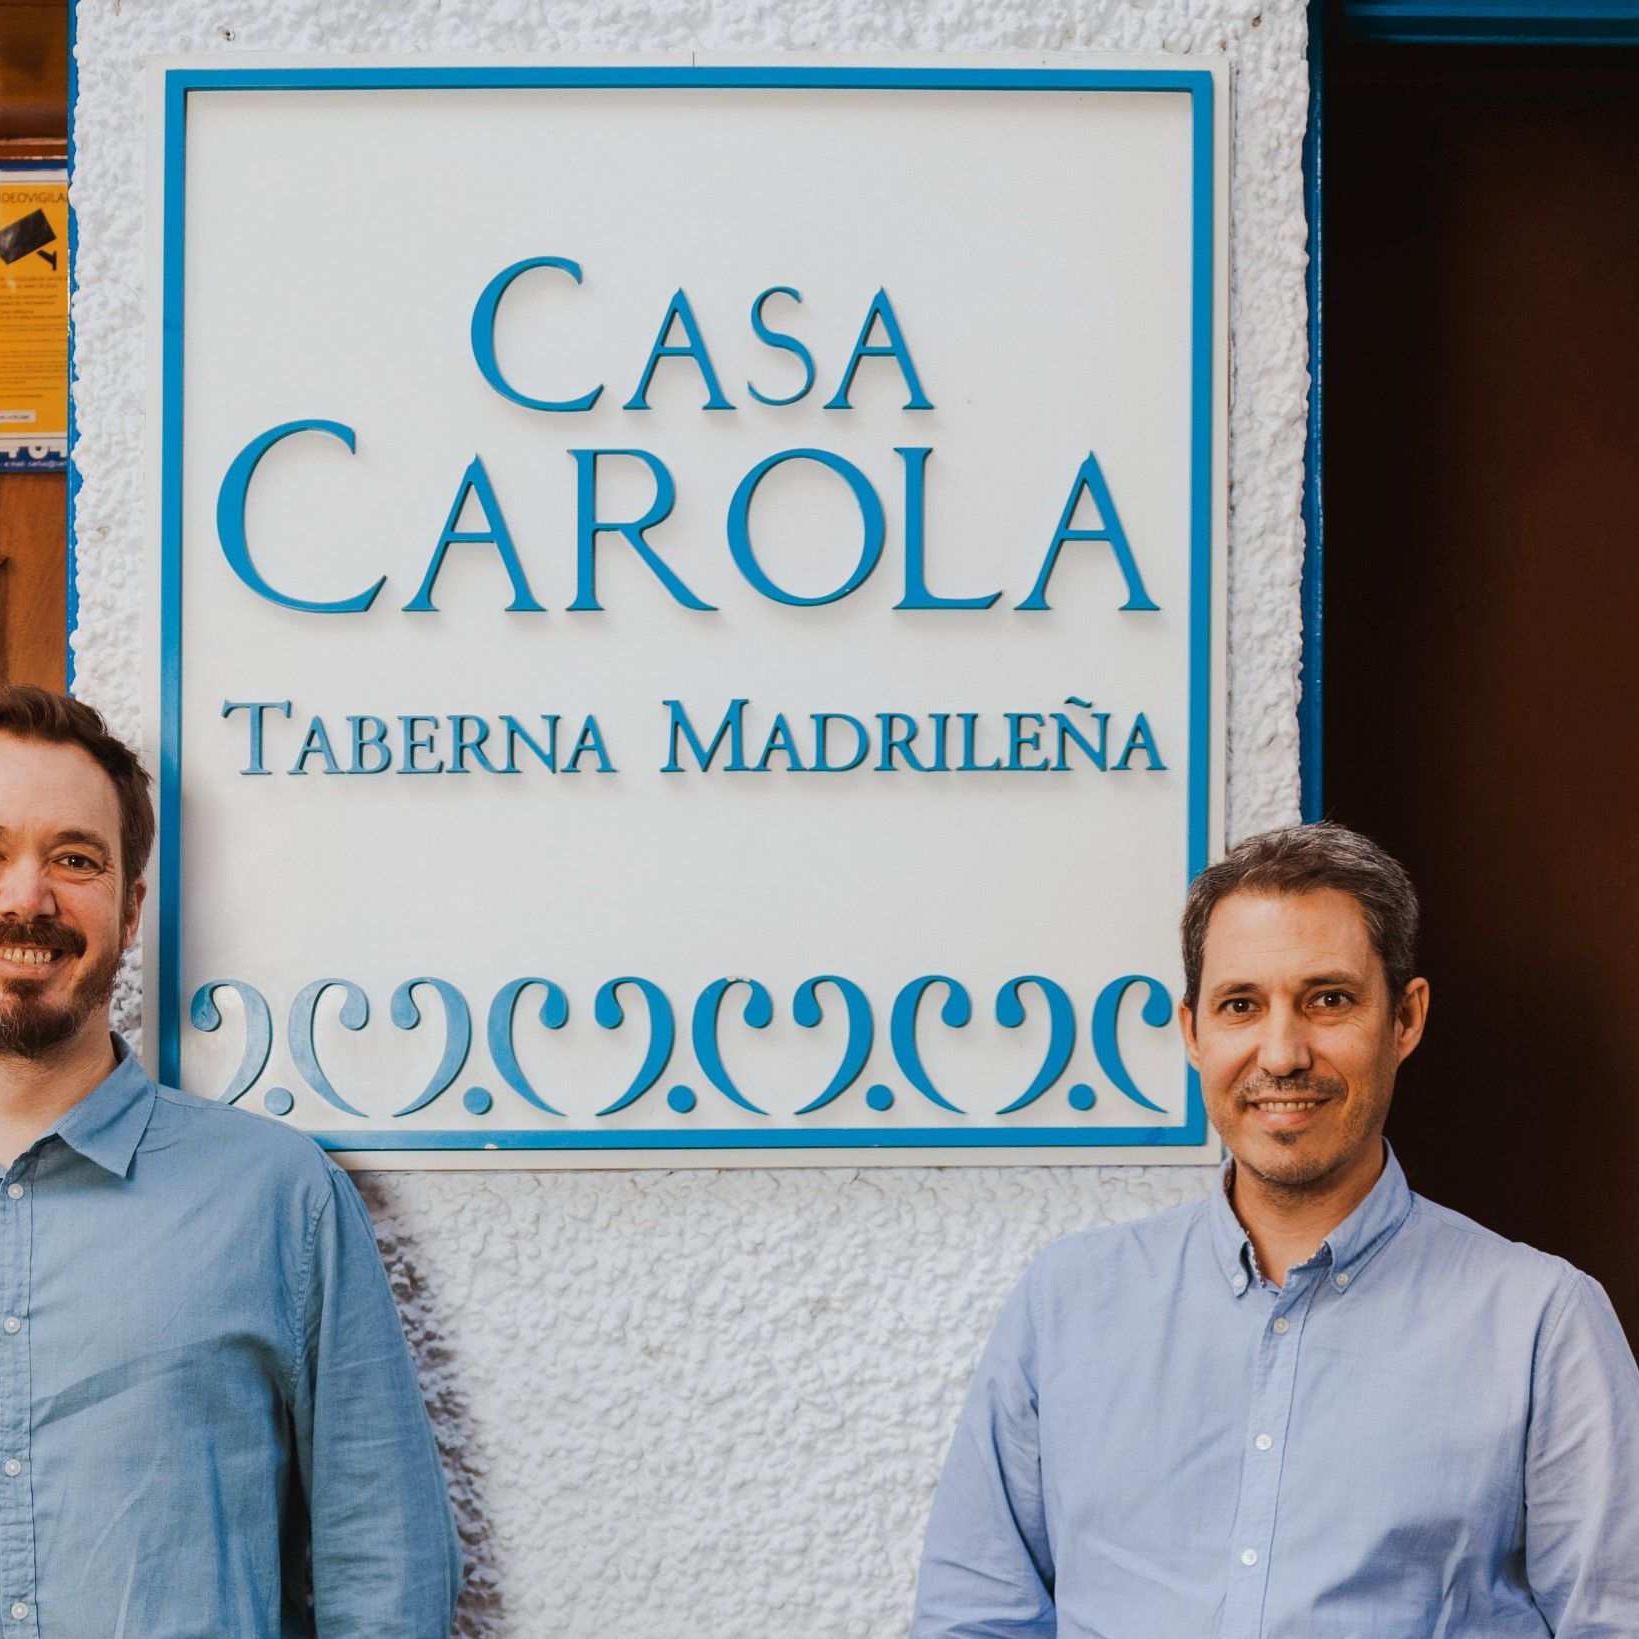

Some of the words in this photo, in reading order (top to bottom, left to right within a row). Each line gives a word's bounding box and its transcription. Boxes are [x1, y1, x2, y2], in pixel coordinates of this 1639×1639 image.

[470, 254, 936, 414] CASA
[215, 418, 1163, 613] CAROLA
[221, 698, 620, 776] TABERNA
[659, 696, 1170, 774] MADRILEÑA
